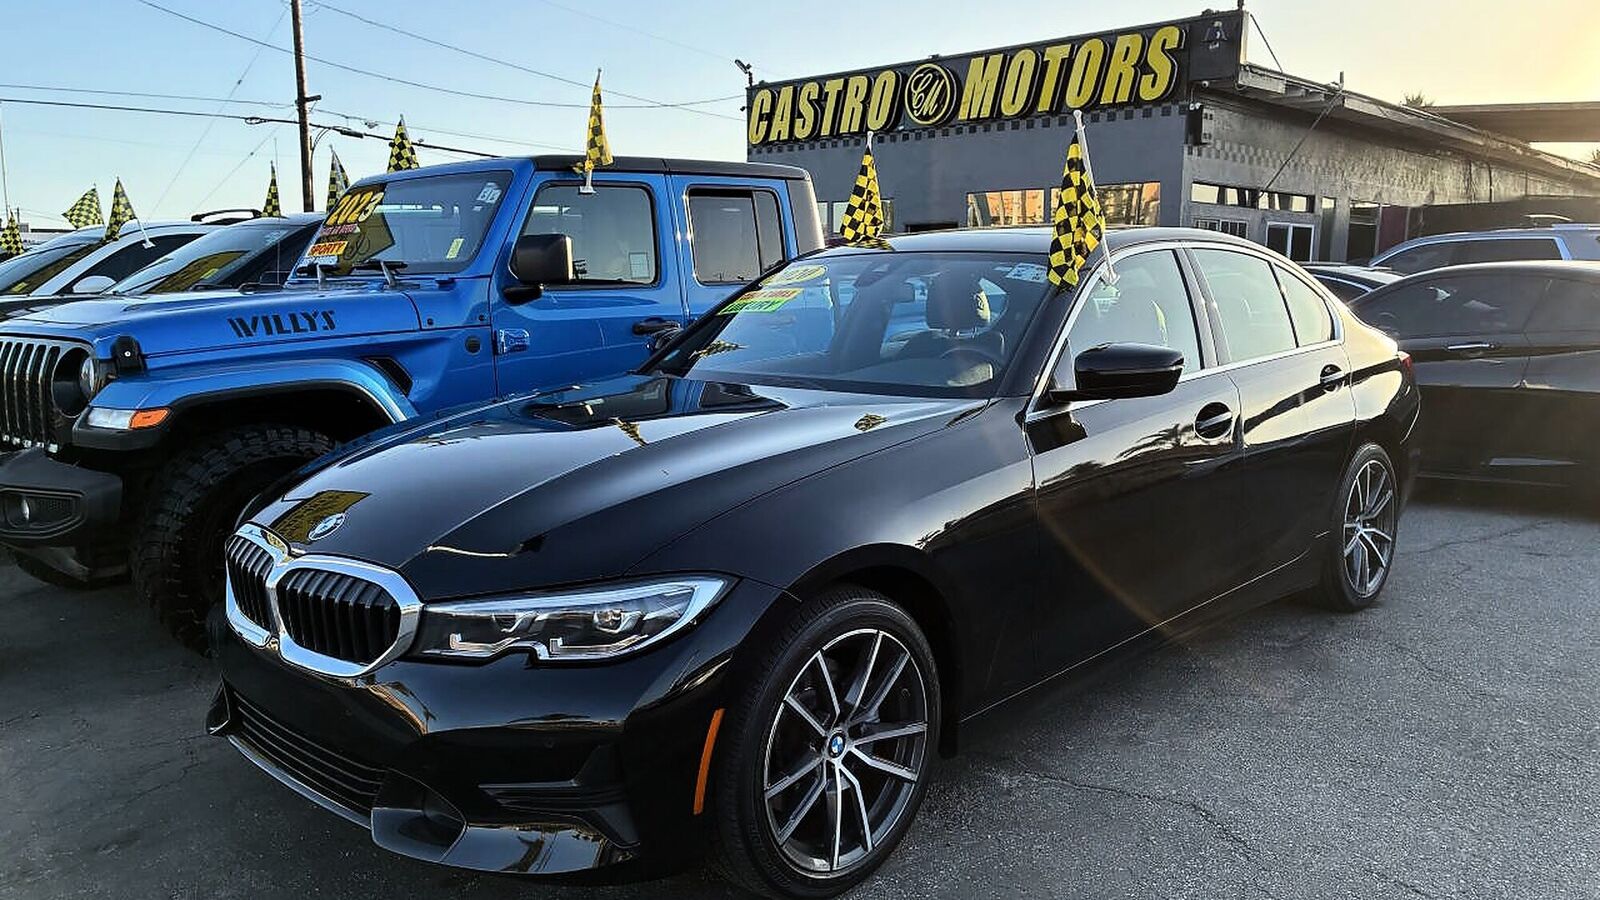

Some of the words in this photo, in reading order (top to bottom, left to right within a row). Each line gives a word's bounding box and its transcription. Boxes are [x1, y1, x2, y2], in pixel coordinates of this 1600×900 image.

[747, 70, 899, 146] CASTRO
[957, 25, 1184, 122] MOTORS
[326, 191, 385, 226] 2023
[226, 310, 336, 338] WILLYS
